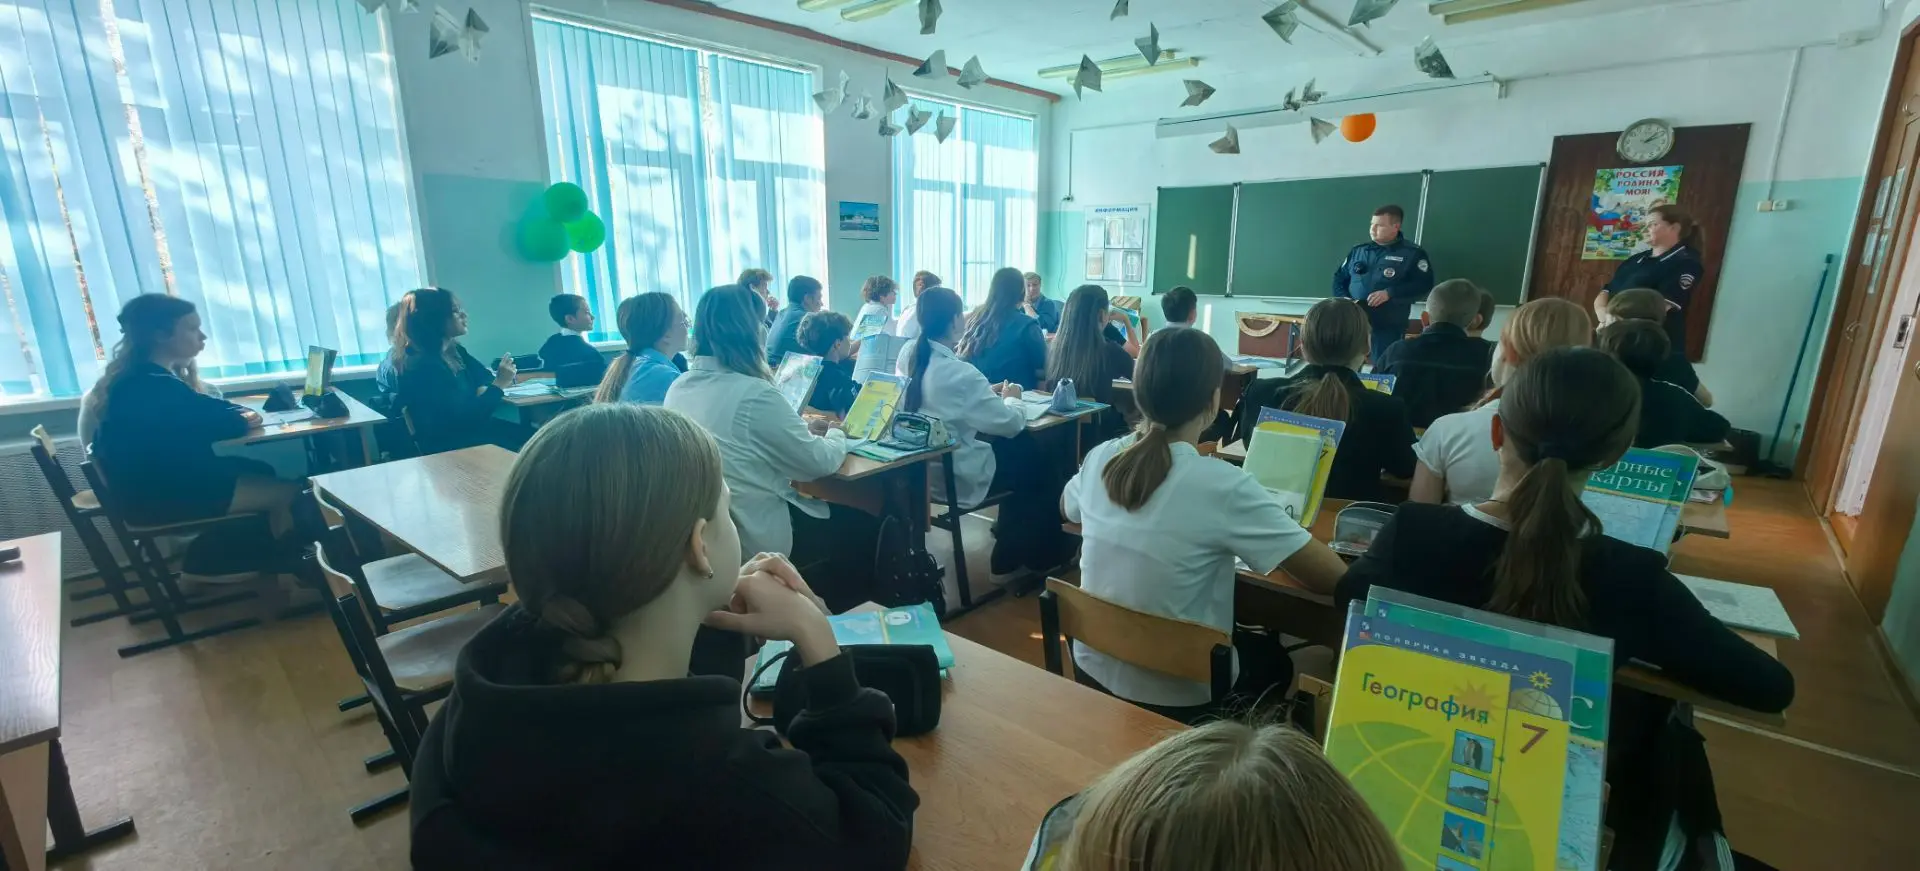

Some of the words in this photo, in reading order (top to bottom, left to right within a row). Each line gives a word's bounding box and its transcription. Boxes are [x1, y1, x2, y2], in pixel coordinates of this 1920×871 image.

[1616, 169, 1664, 178] РОССИЯ
[1617, 179, 1659, 187] РОДИНА
[1604, 461, 1672, 477] рные
[1591, 471, 1668, 492] карты
[1374, 631, 1451, 655] ПОЛЯРНАЯ
[1458, 651, 1520, 671] ЗВЕЗДА
[1362, 672, 1490, 724] География
[1520, 722, 1548, 754] 7
